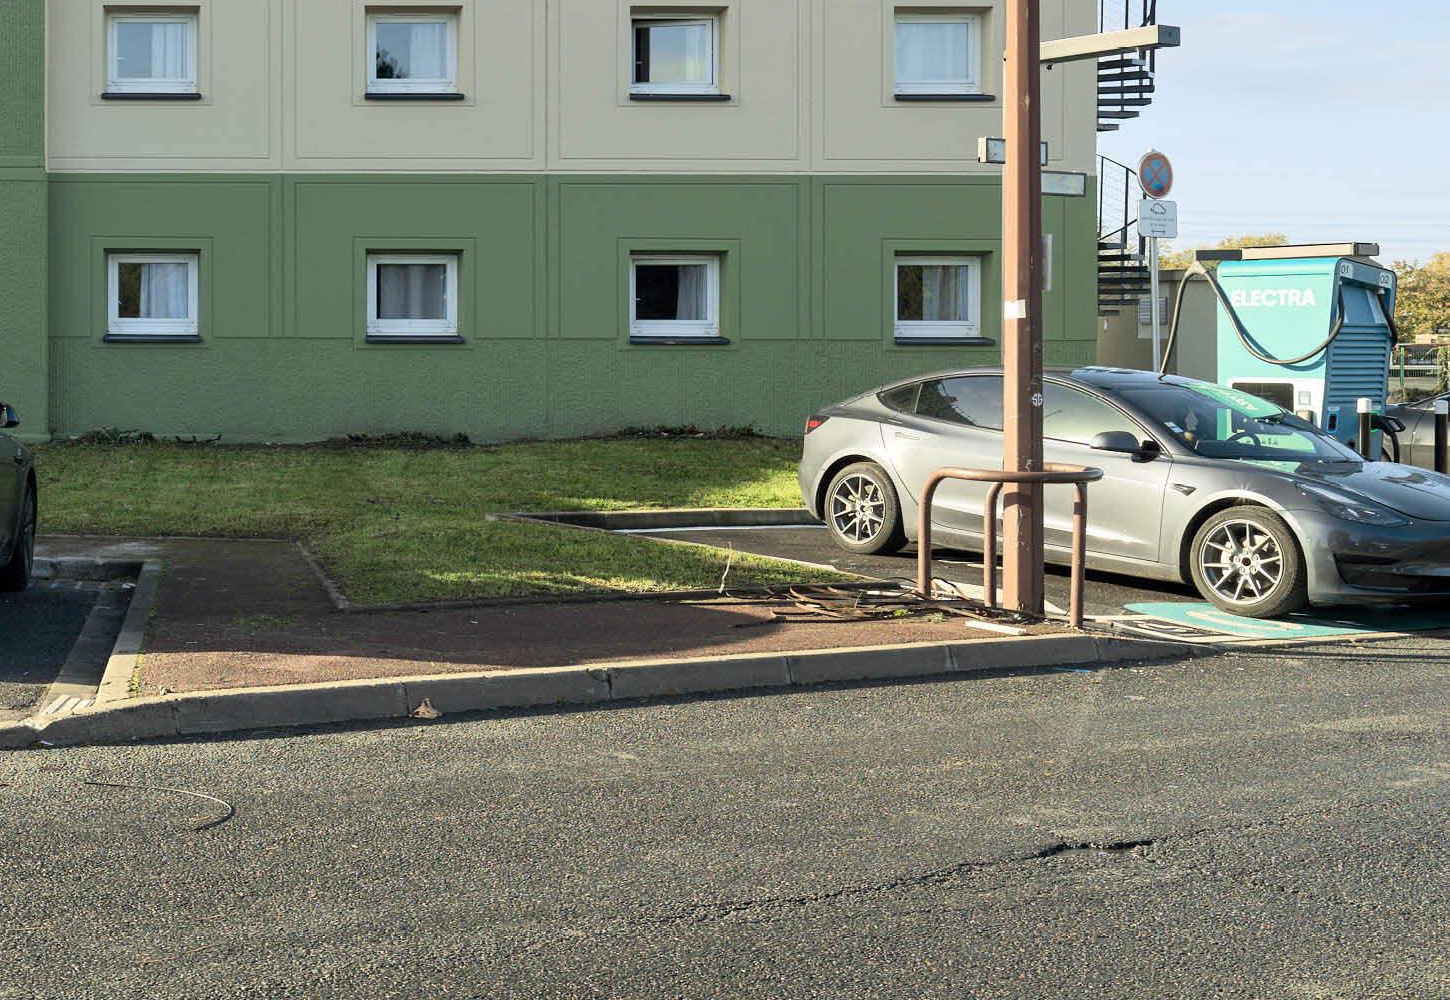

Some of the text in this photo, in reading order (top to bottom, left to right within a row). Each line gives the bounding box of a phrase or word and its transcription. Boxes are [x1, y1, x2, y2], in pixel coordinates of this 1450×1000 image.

[1340, 264, 1350, 274] 01
[1380, 275, 1390, 284] 02
[1231, 288, 1317, 307] ELECTRA
